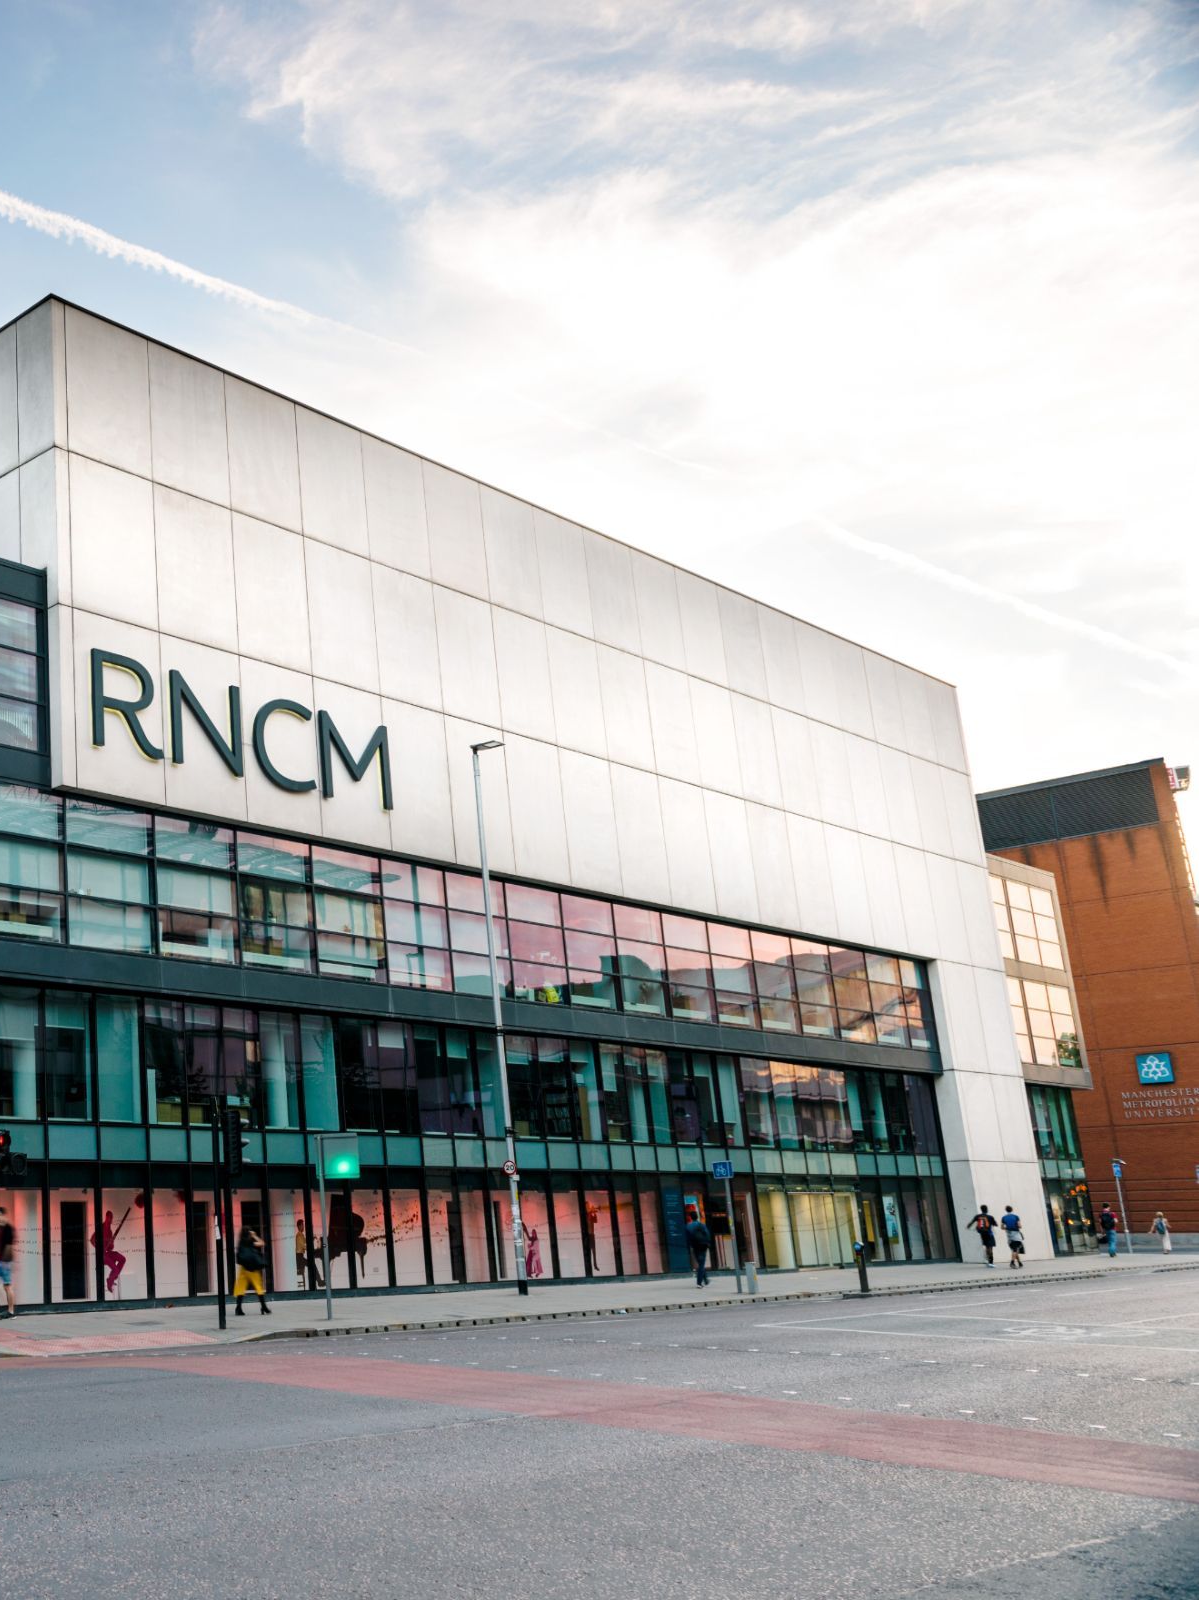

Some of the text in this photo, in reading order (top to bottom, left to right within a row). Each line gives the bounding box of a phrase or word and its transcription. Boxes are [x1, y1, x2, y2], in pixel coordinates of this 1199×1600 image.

[90, 648, 393, 811] RNCM
[1121, 1088, 1199, 1098] MANCHESTER
[1125, 1107, 1199, 1118] UNIVERSIT
